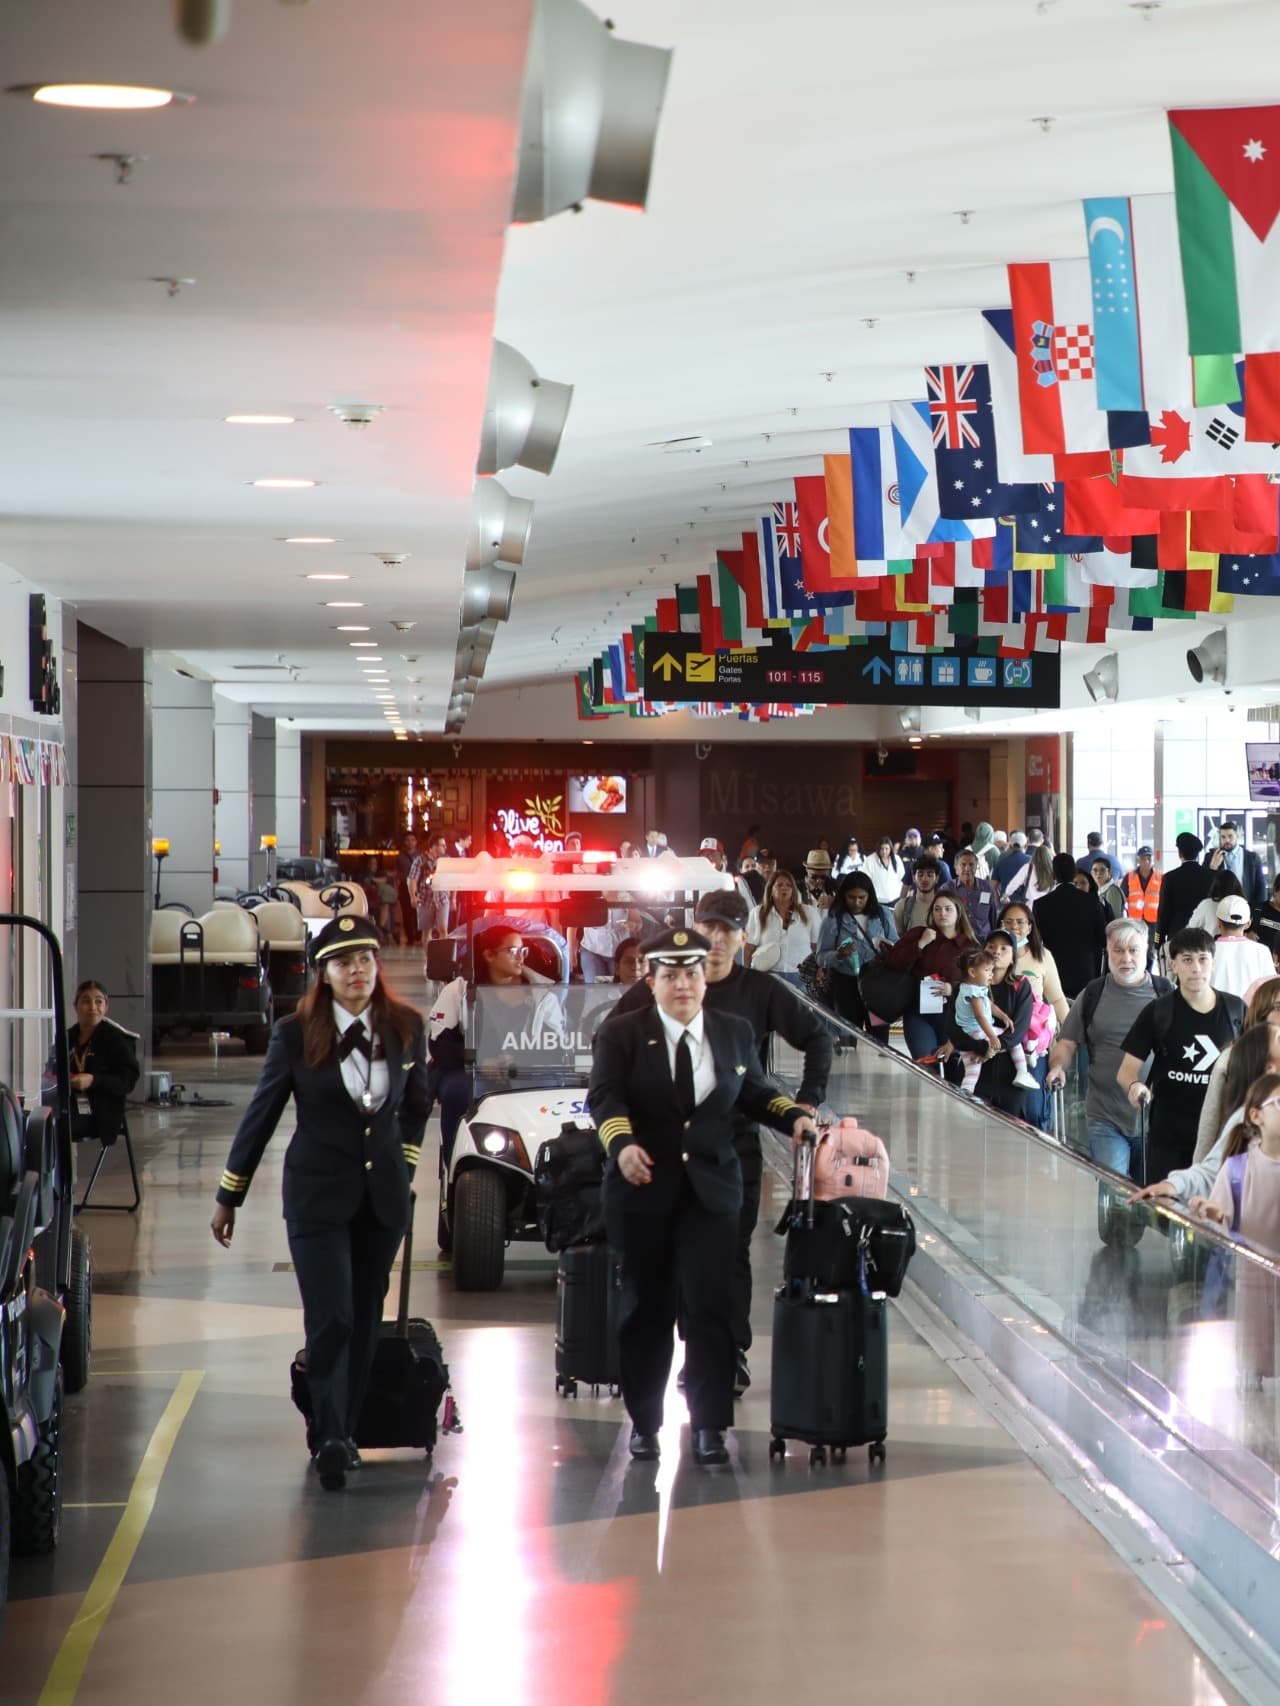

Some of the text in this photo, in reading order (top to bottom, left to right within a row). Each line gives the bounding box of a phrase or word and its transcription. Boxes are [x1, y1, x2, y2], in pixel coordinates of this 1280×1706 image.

[718, 654, 759, 664] Puertas
[718, 665, 743, 674] Gates
[718, 675, 742, 683] Portas
[767, 671, 788, 682] 101
[800, 672, 822, 683] 115
[705, 769, 858, 817] Misawa
[501, 1031, 593, 1051] AMBUL
[1167, 1070, 1209, 1085] CONVE
